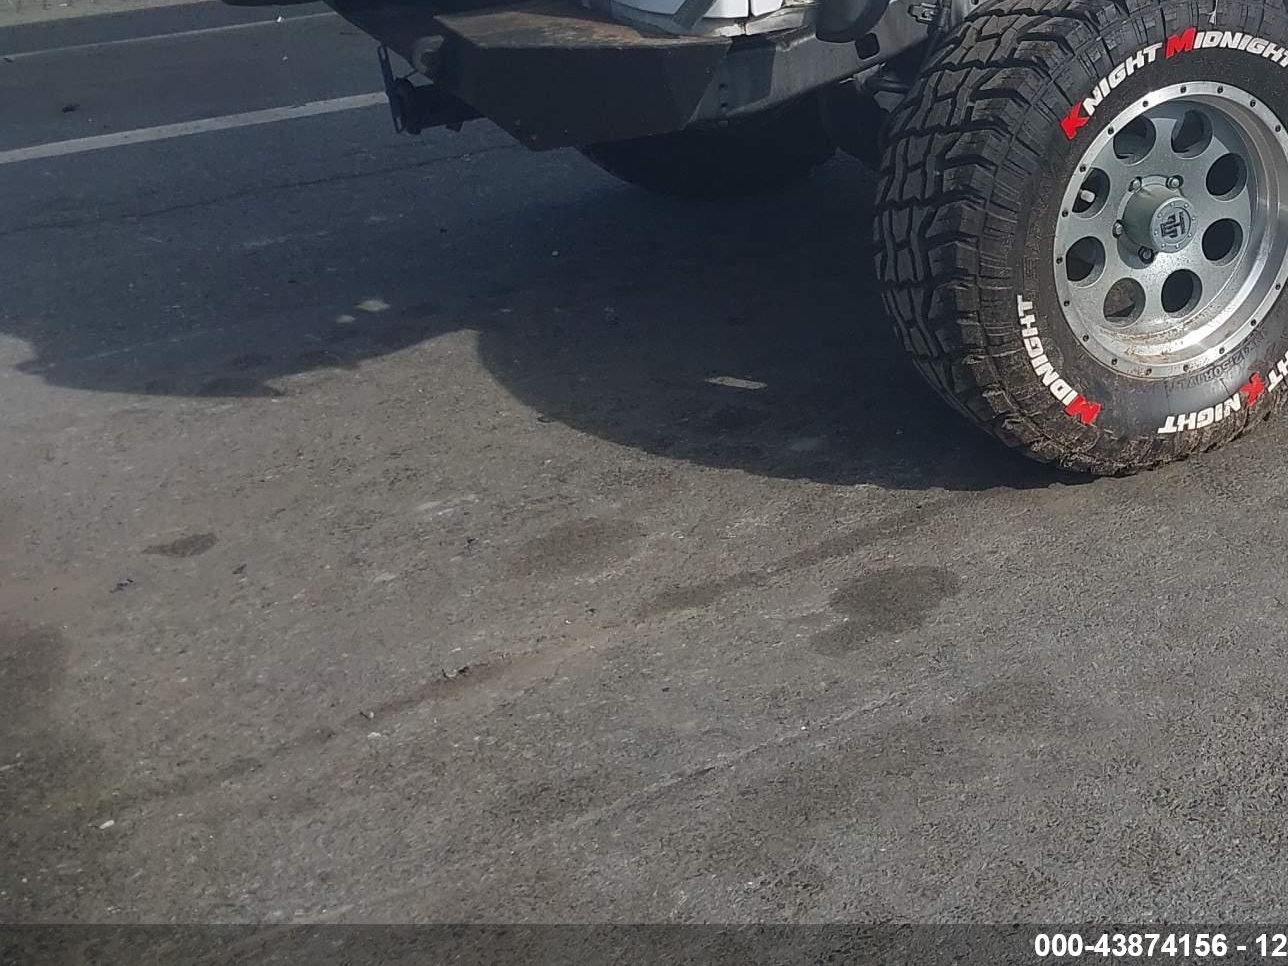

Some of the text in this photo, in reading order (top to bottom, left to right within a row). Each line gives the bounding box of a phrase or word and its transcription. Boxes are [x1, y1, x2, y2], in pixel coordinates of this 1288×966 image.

[1061, 42, 1163, 140] KNIGHT
[1017, 294, 1101, 425] MIDNIGHT
[1157, 371, 1265, 434] KNIGHT
